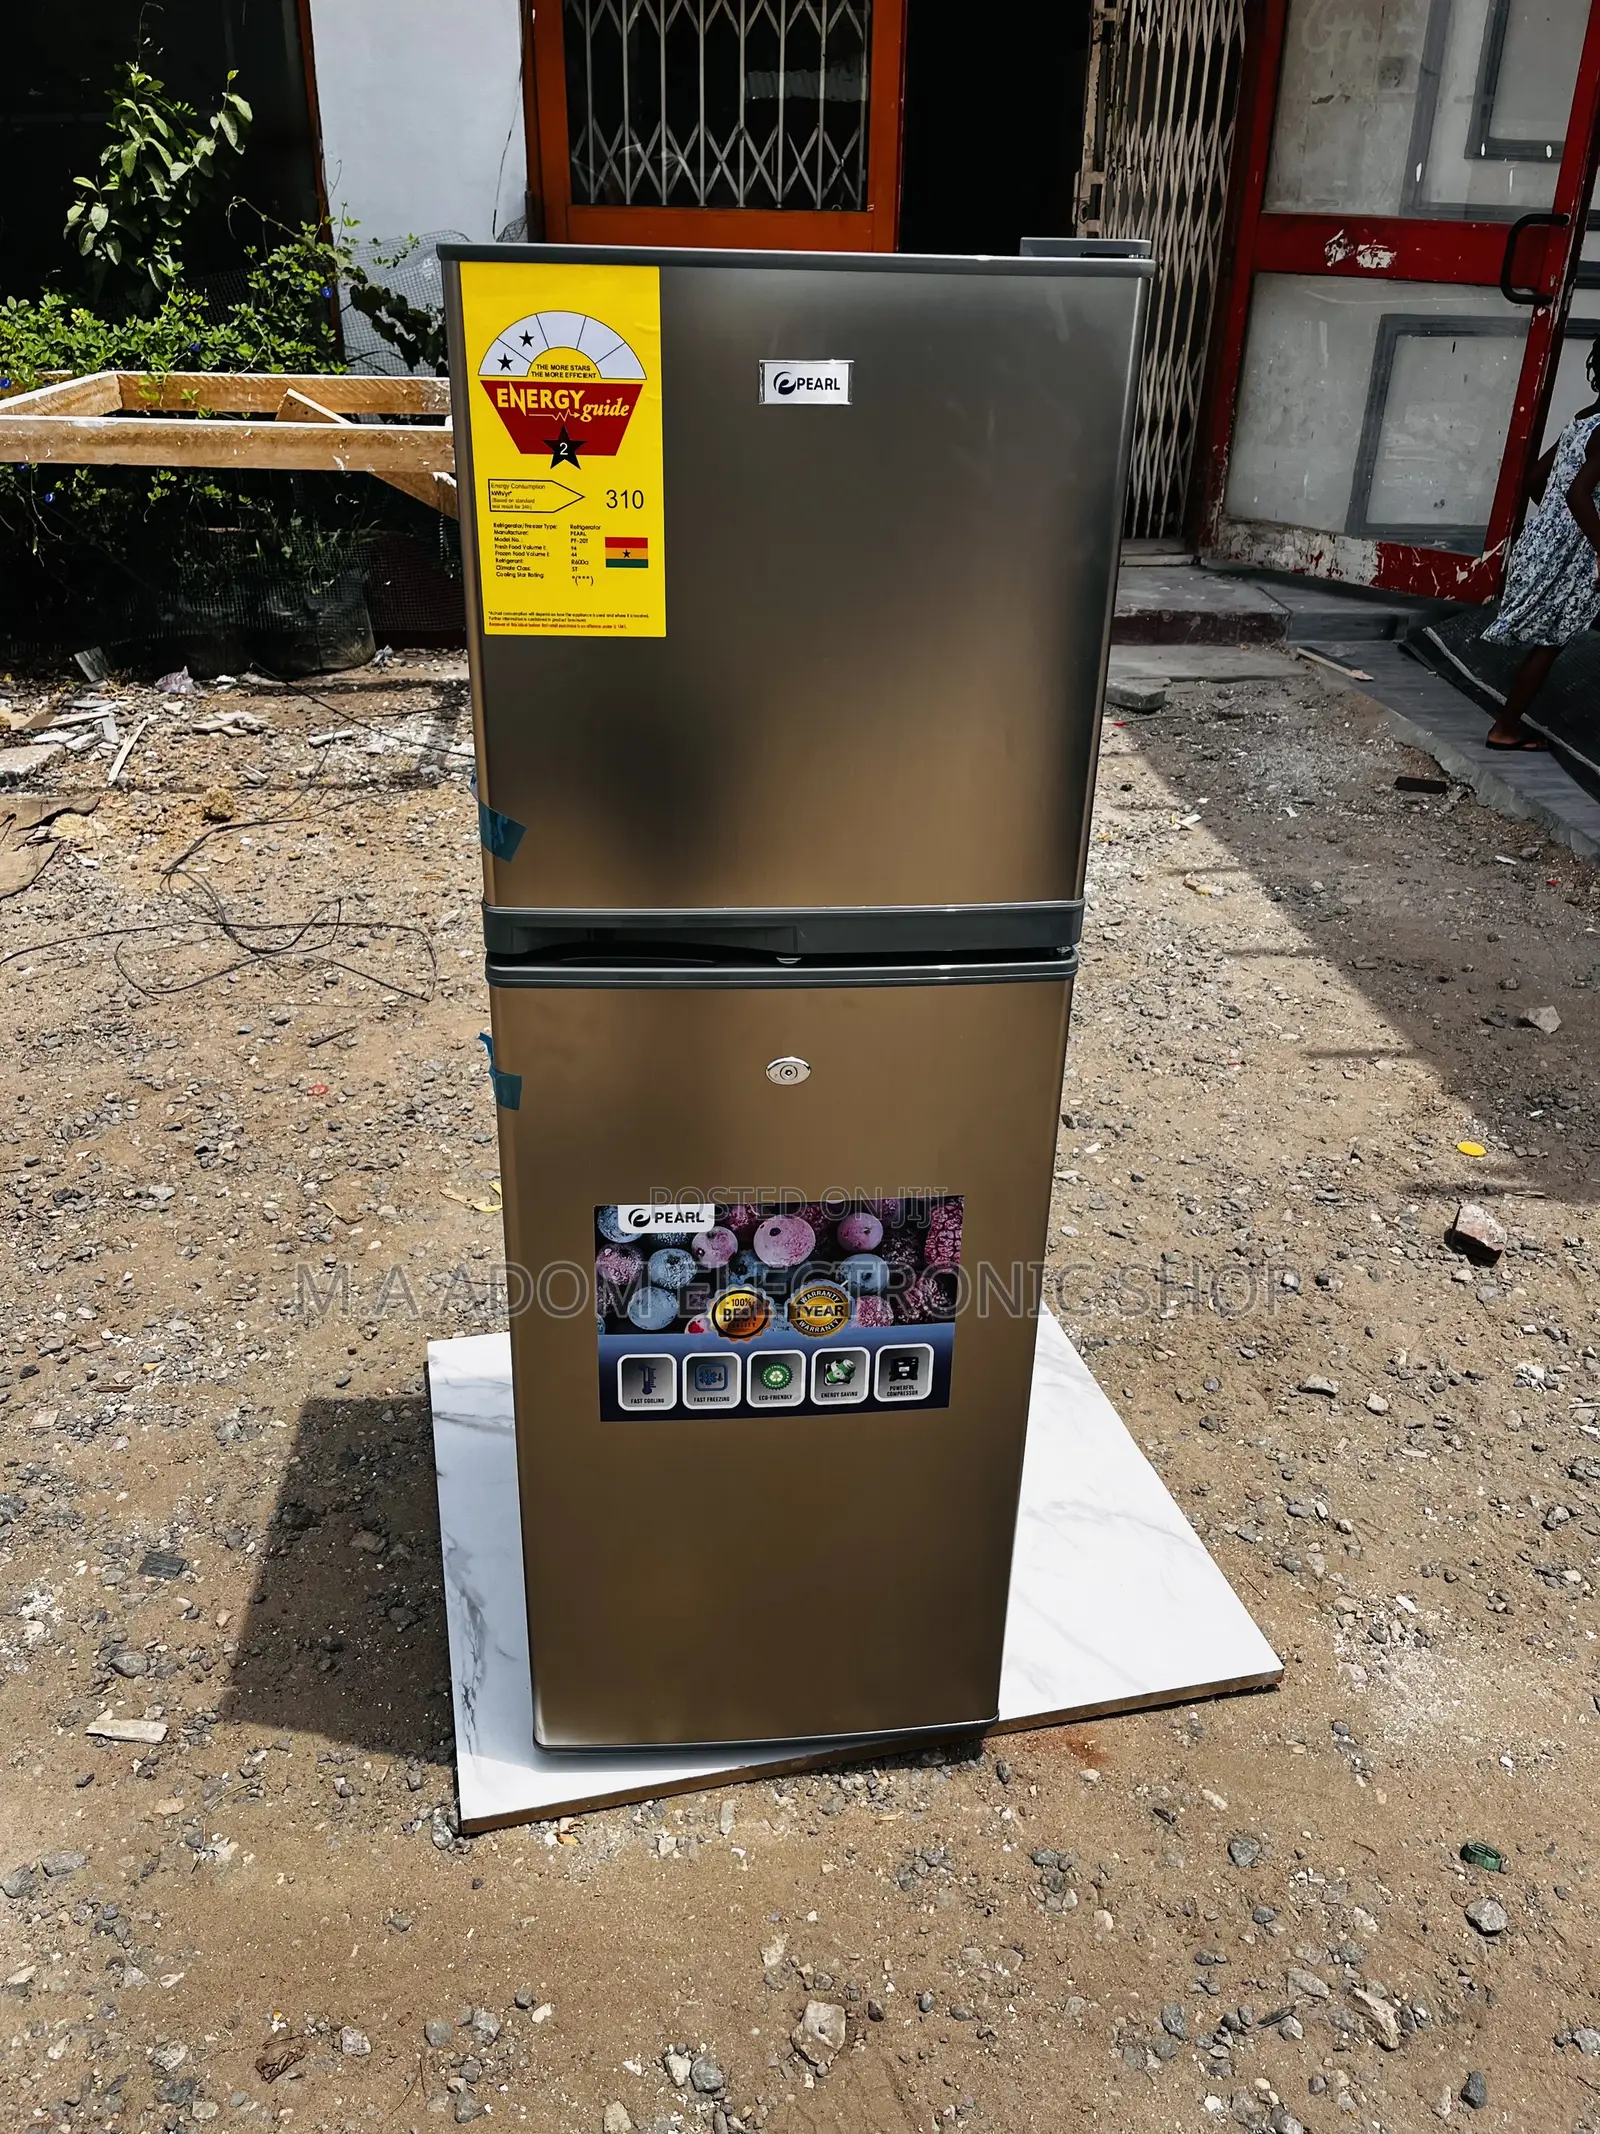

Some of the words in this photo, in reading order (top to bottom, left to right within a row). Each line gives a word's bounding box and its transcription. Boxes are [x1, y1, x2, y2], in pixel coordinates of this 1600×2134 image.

[797, 378, 840, 390] PEARL
[496, 382, 586, 416] ENERGY
[580, 398, 629, 423] guide
[559, 442, 568, 455] 2
[606, 489, 644, 509] 310
[655, 1212, 705, 1223] PEARL
[732, 1298, 752, 1306] 100%
[800, 1289, 840, 1304] WARRANTY
[804, 1305, 844, 1317] YEAR
[799, 1319, 839, 1333] WARRANTY
